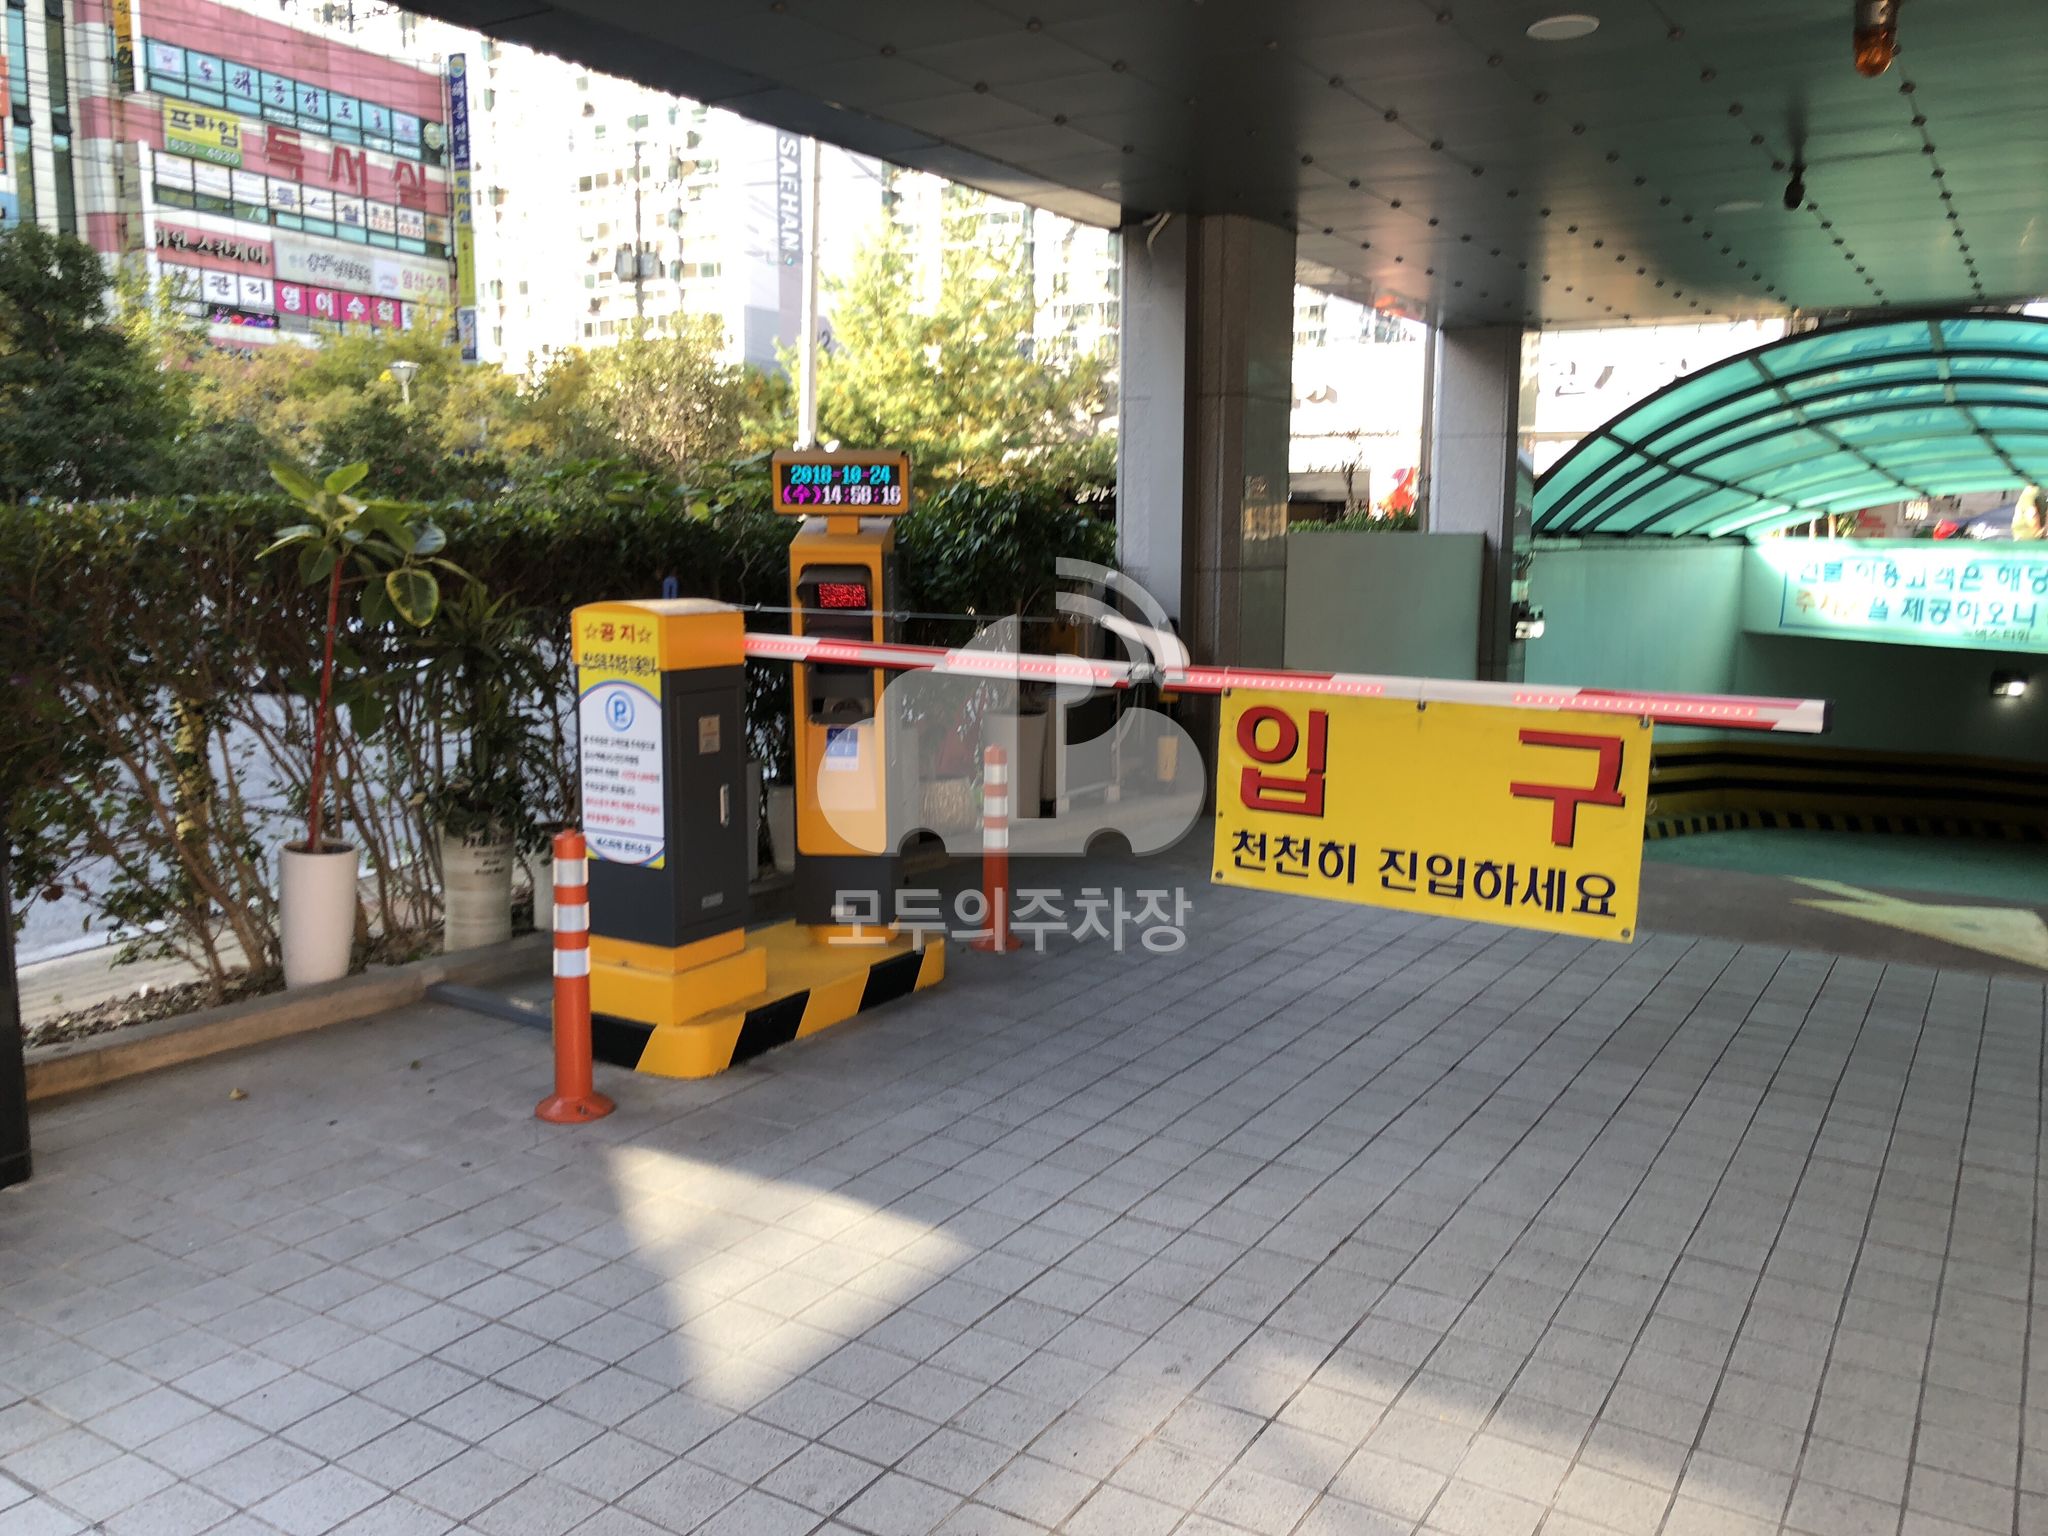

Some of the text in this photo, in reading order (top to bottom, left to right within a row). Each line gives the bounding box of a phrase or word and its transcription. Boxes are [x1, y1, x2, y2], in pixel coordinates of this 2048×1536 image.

[170, 109, 240, 149] 프라임
[265, 125, 426, 208] 독서실
[779, 136, 800, 251] SAEHAN
[1231, 829, 1618, 918] 천천히 진입하세요
